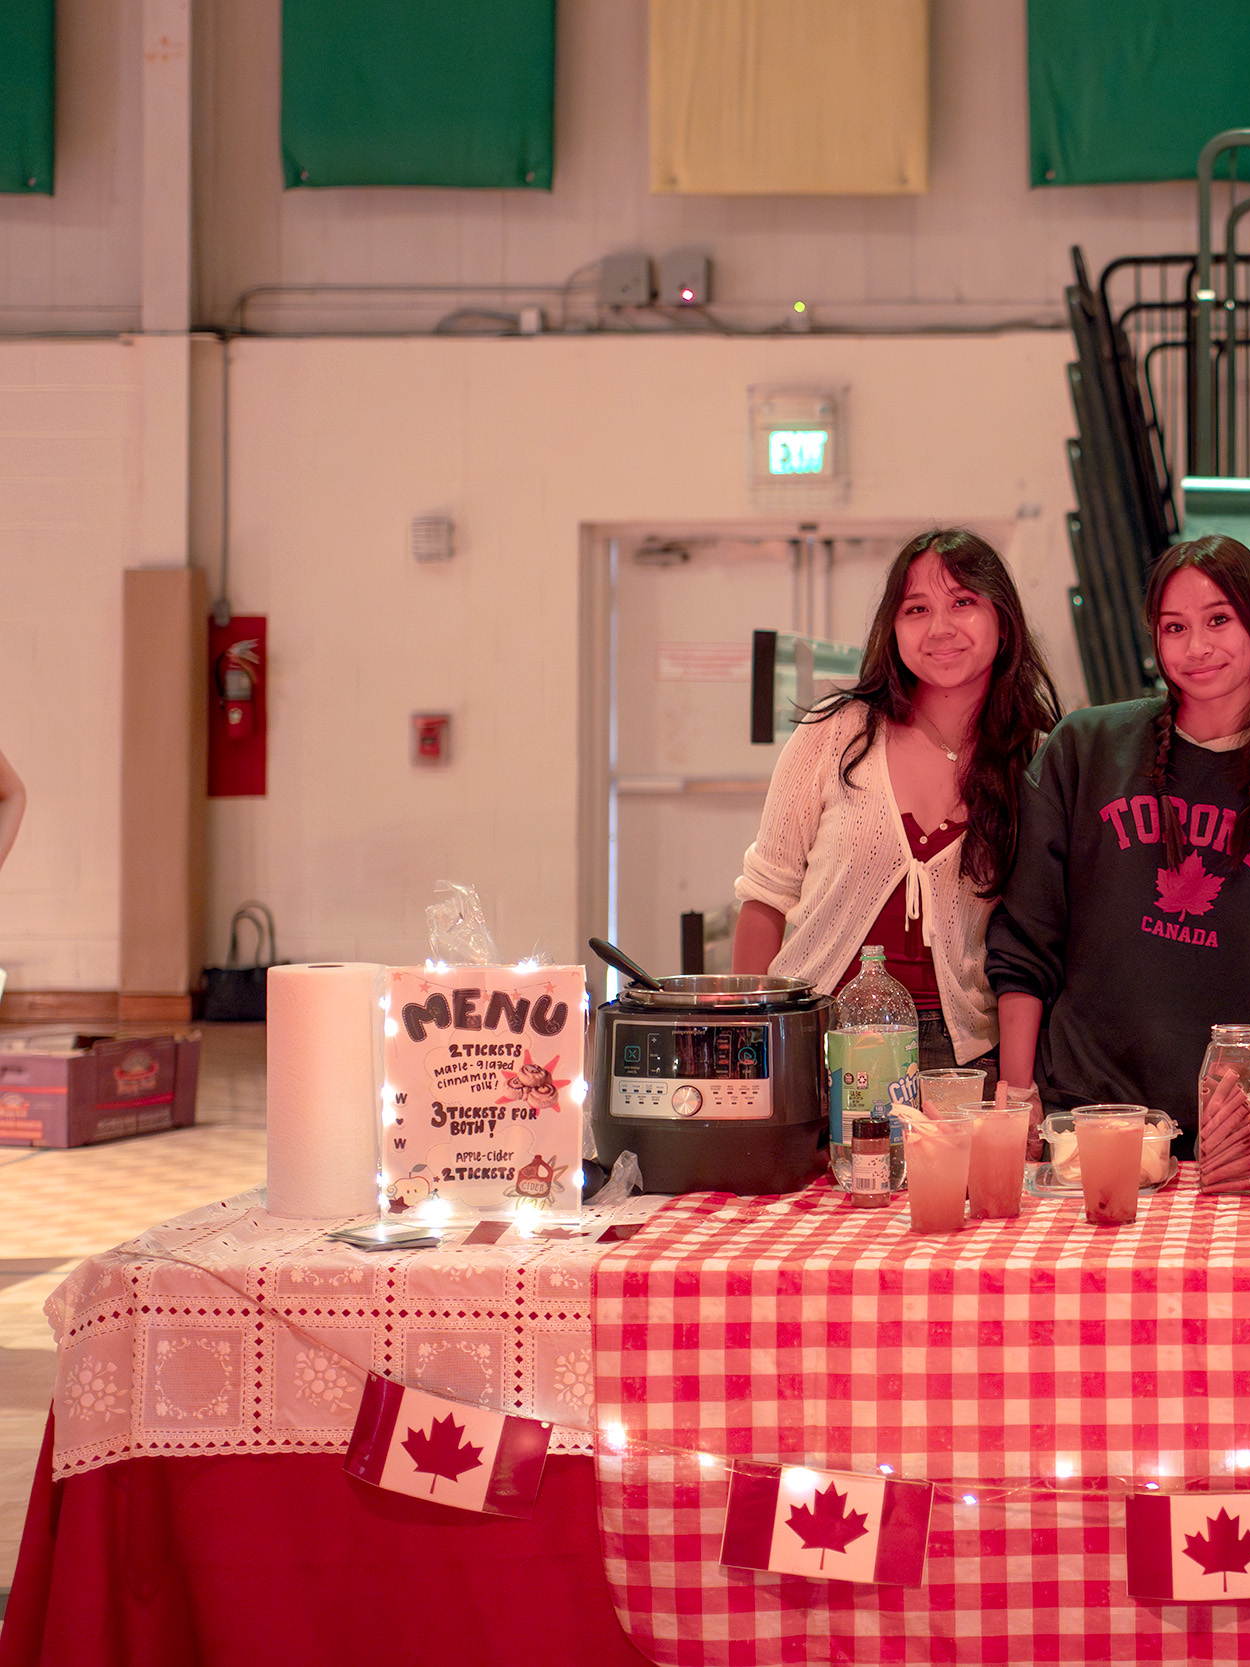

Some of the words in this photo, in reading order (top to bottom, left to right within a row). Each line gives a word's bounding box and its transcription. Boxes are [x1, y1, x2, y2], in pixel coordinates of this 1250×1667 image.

[1141, 915, 1219, 948] CANADA
[402, 988, 568, 1042] MENU
[449, 1044, 462, 1058] 2
[462, 1043, 522, 1058] TICKETS
[437, 1072, 497, 1090] cinnamon
[431, 1101, 447, 1128] 3
[446, 1106, 506, 1121] TICKETS
[511, 1107, 537, 1121] FOR
[441, 1167, 455, 1181] 2
[455, 1166, 515, 1181] TICKETS
